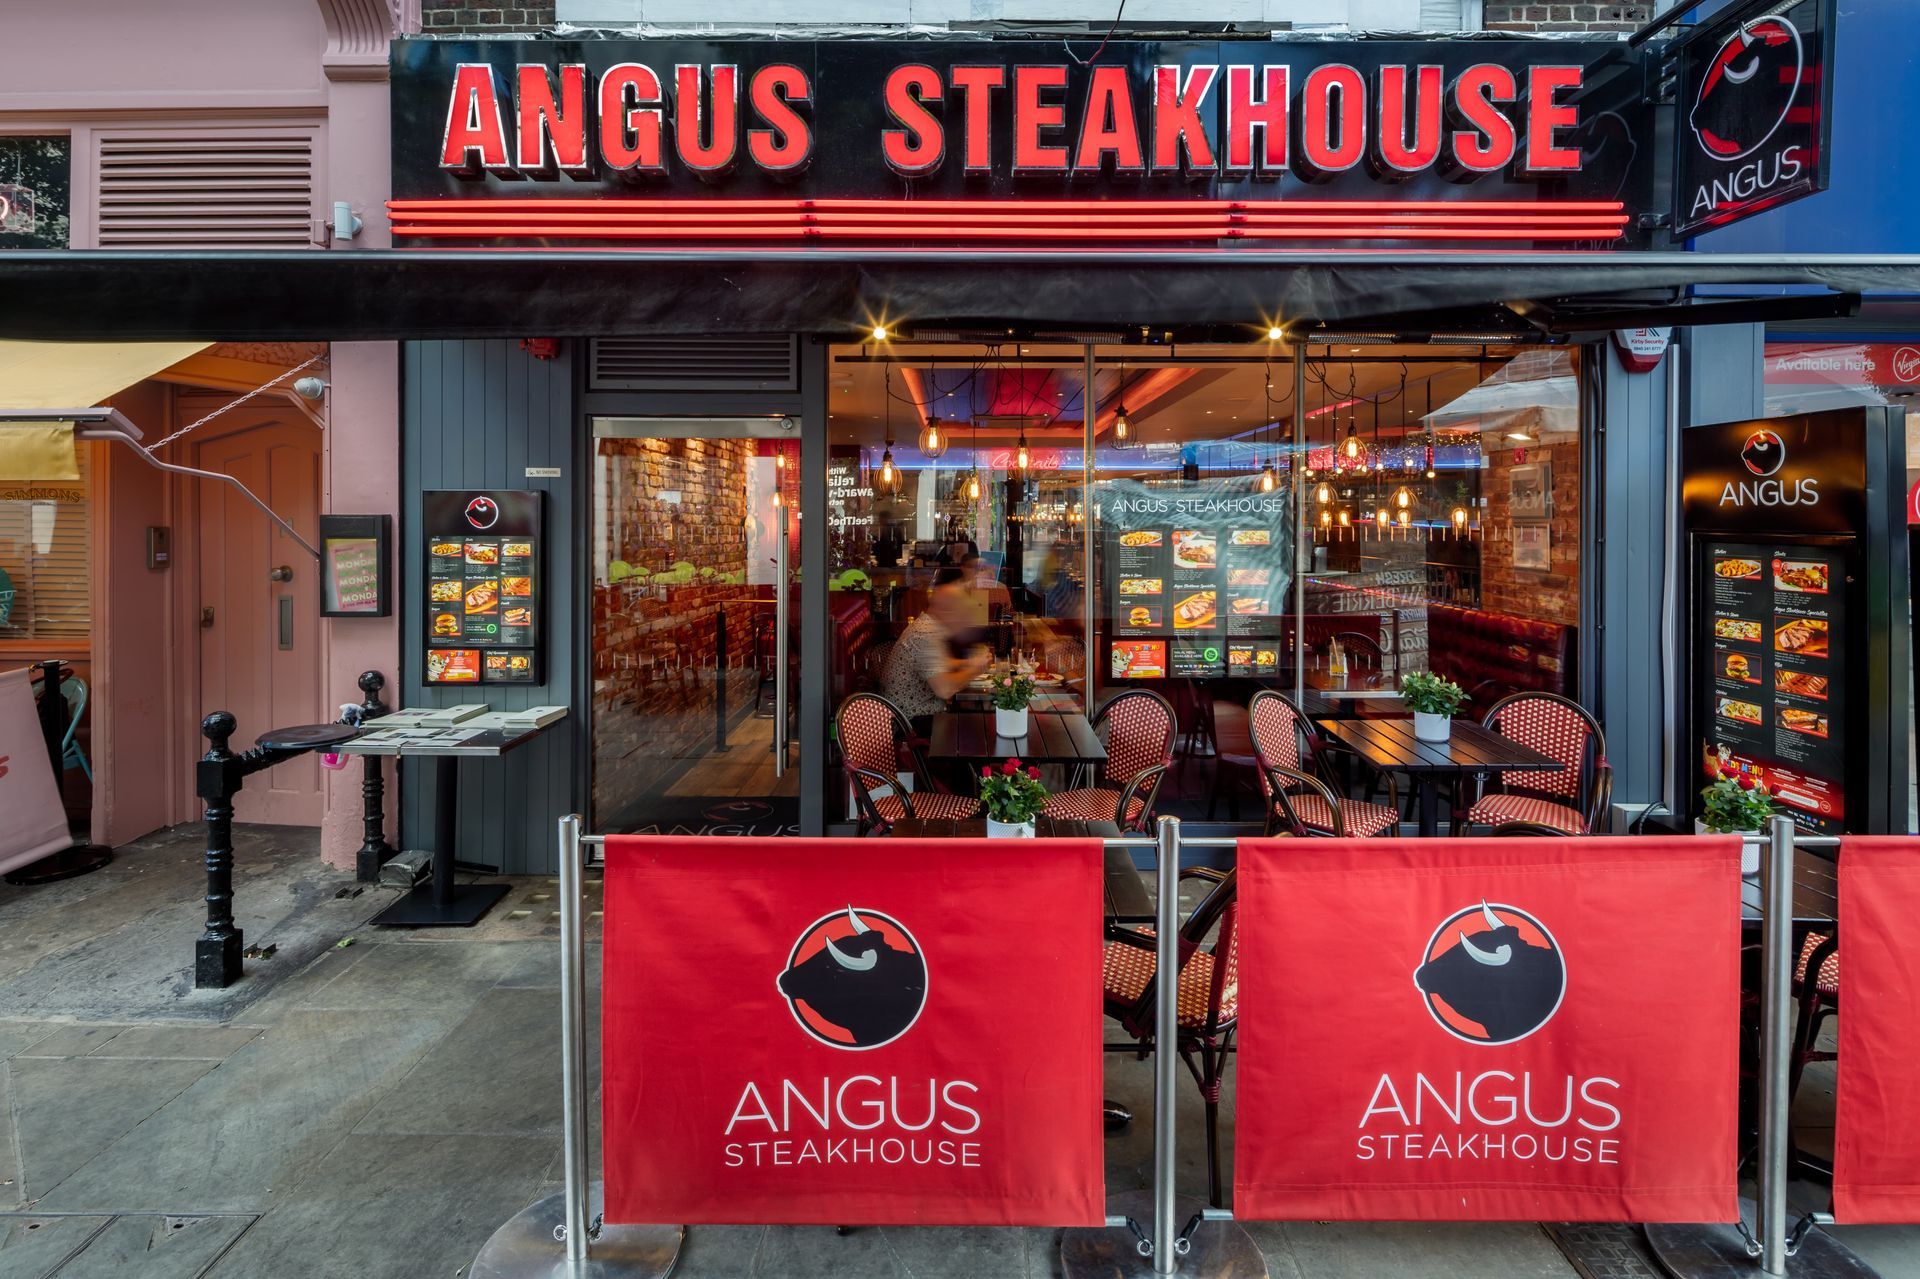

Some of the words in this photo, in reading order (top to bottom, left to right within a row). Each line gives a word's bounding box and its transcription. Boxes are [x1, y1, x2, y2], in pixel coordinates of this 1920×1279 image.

[438, 62, 815, 172] ANGUS
[882, 62, 1585, 174] STEAKHOUSE
[1690, 145, 1802, 218] ANGUS
[1776, 358, 1841, 371] Available
[1845, 358, 1876, 371] here
[4, 487, 81, 503] SIMMONS
[1112, 499, 1168, 513] ANGUS
[1175, 499, 1282, 513] STEAKHOUSE
[1720, 478, 1819, 507] ANGUS
[339, 574, 377, 587] MONDA
[724, 1074, 981, 1136] ANGUS
[1358, 1070, 1621, 1133] ANGUS
[724, 1138, 981, 1168] STEAKHOUSE
[1356, 1133, 1620, 1165] STEAKHOUSE
